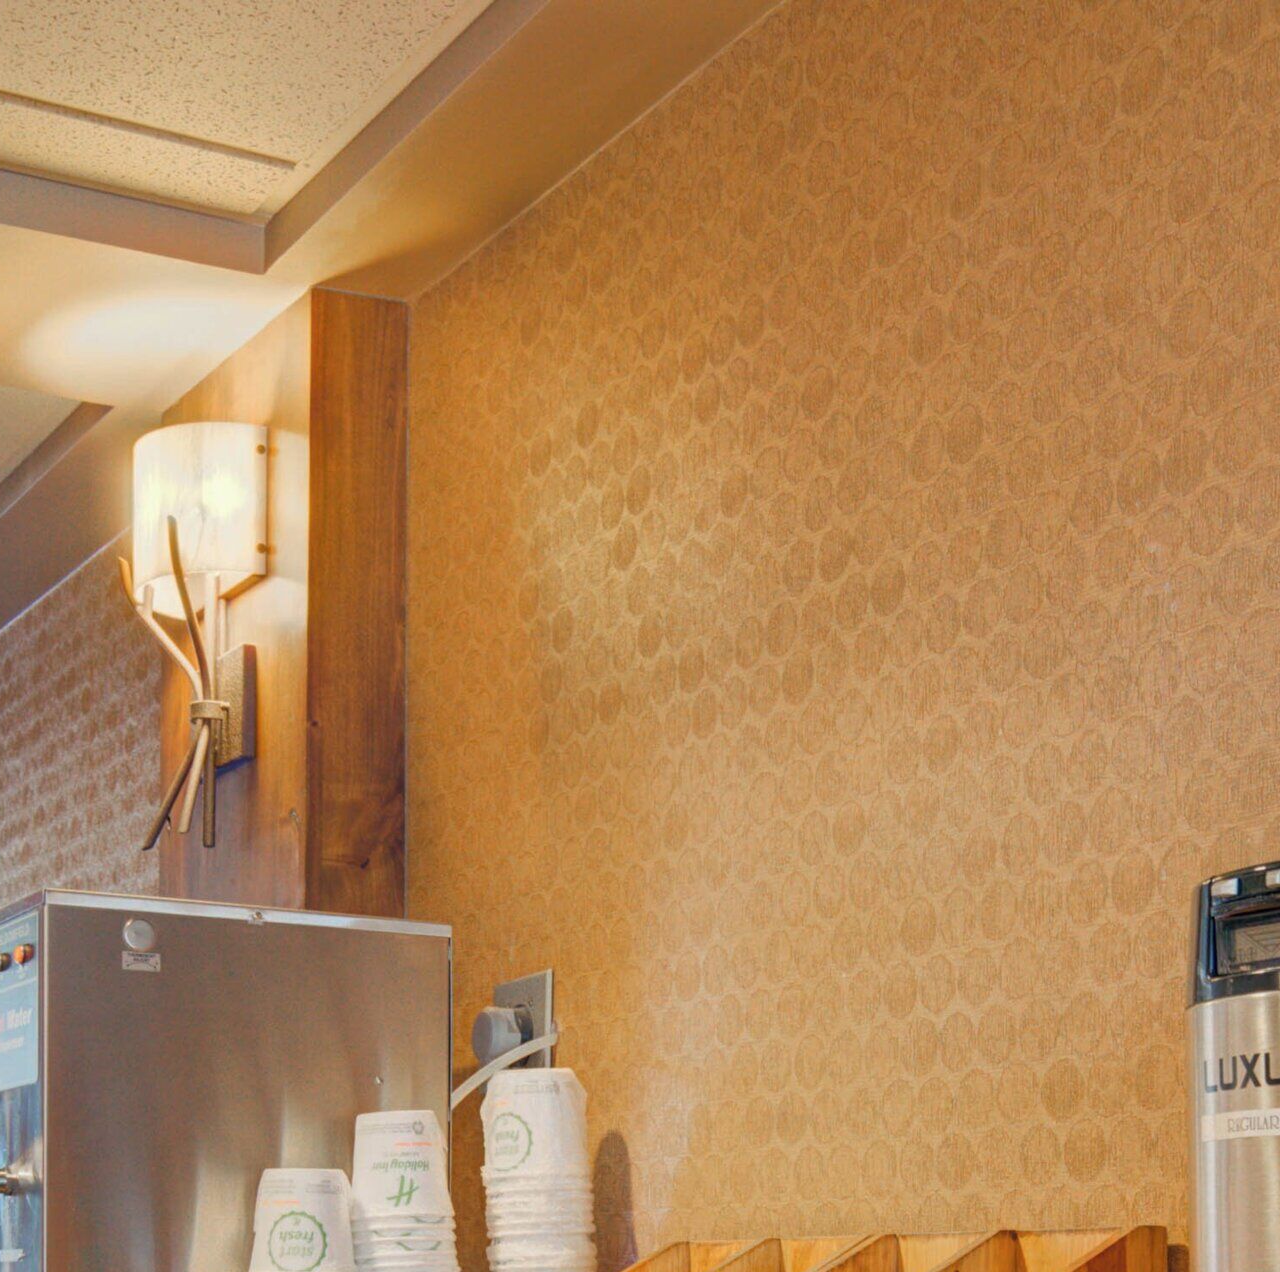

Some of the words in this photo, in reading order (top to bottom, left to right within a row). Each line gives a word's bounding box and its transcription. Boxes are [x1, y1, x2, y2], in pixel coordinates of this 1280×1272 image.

[1227, 1114, 1280, 1133] REGULAR
[390, 1159, 430, 1171] Holiday
[279, 1231, 314, 1243] fresh
[279, 1246, 313, 1258] start
